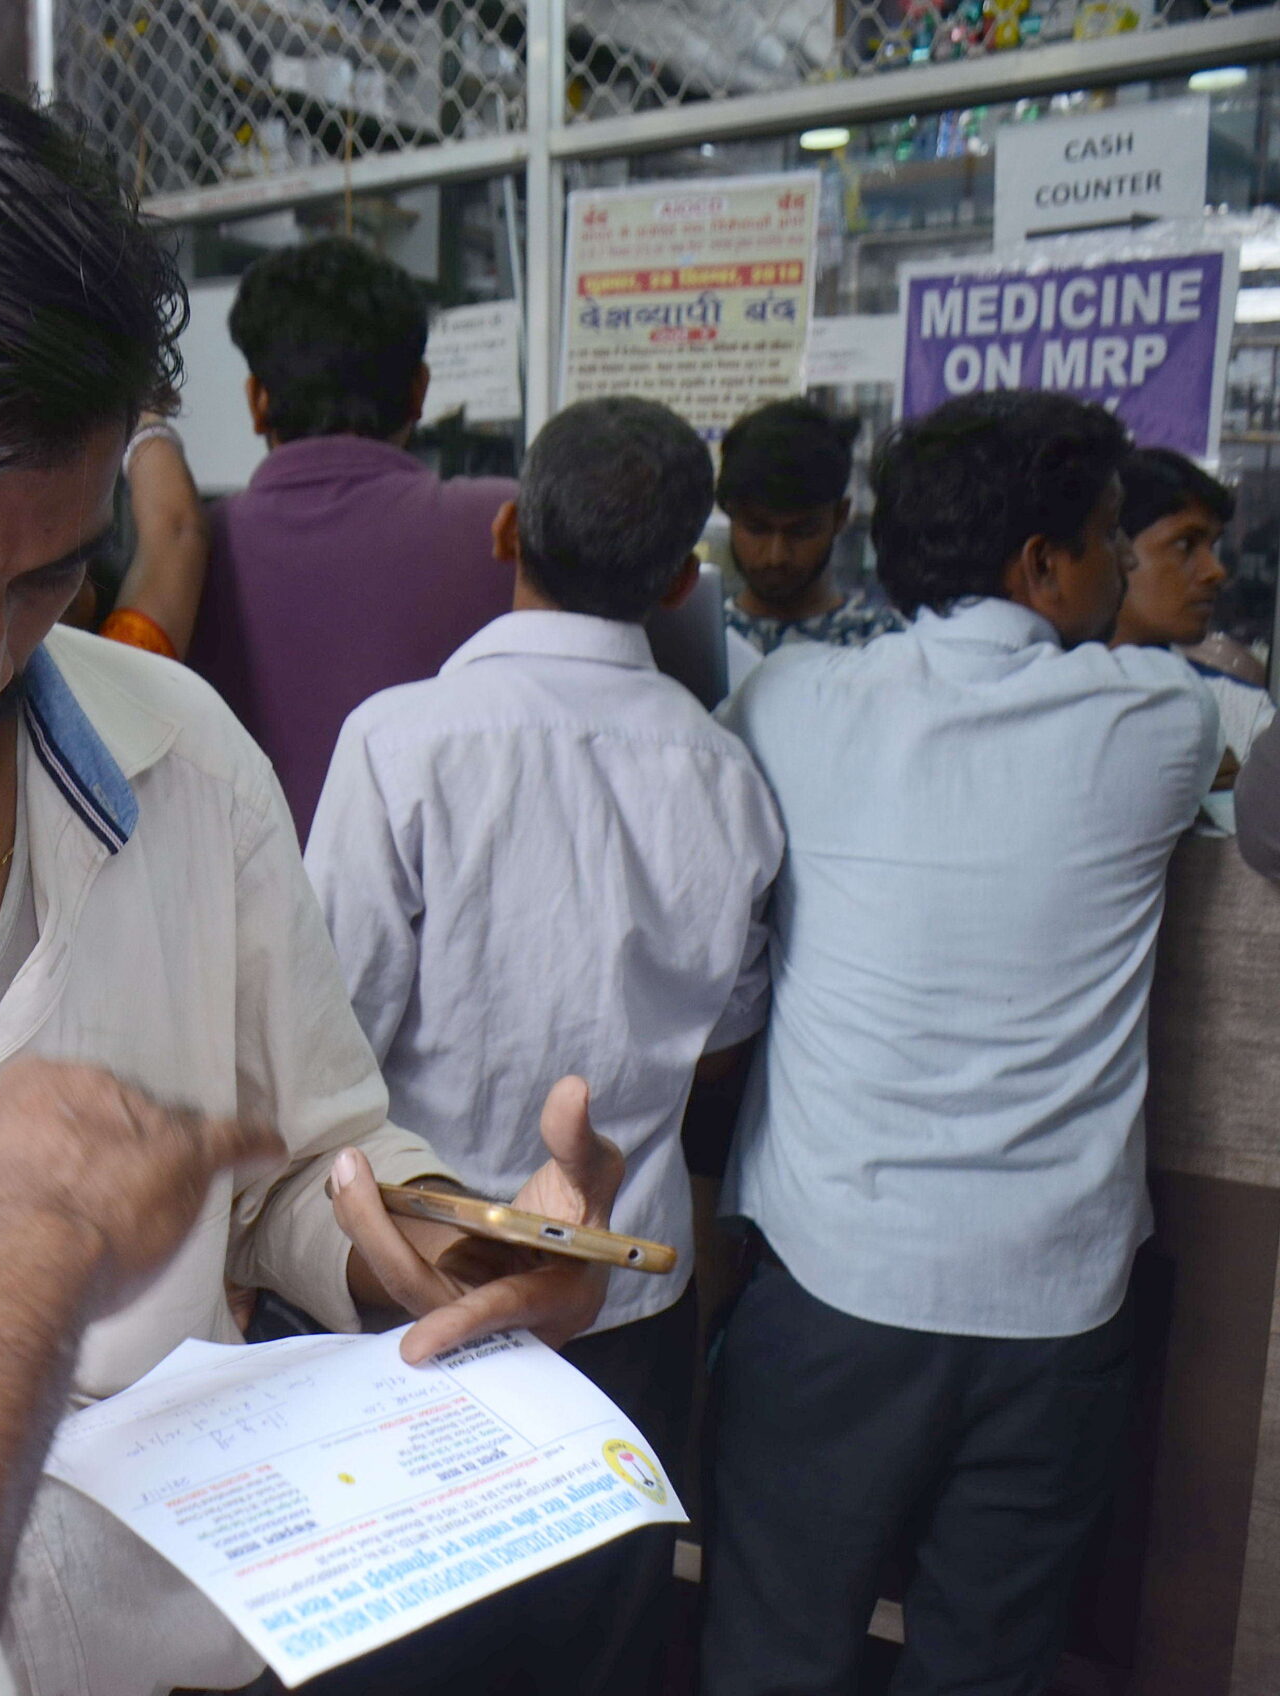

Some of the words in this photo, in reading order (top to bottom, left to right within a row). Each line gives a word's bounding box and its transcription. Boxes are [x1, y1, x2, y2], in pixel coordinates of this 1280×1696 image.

[1064, 132, 1134, 163] CASH
[1036, 169, 1162, 208] COUNTER
[579, 291, 722, 332] देशव्यापी
[746, 289, 797, 322] बंद
[920, 268, 1204, 340] MEDICINE
[943, 342, 1021, 395] ON
[1041, 334, 1169, 390] MRP
